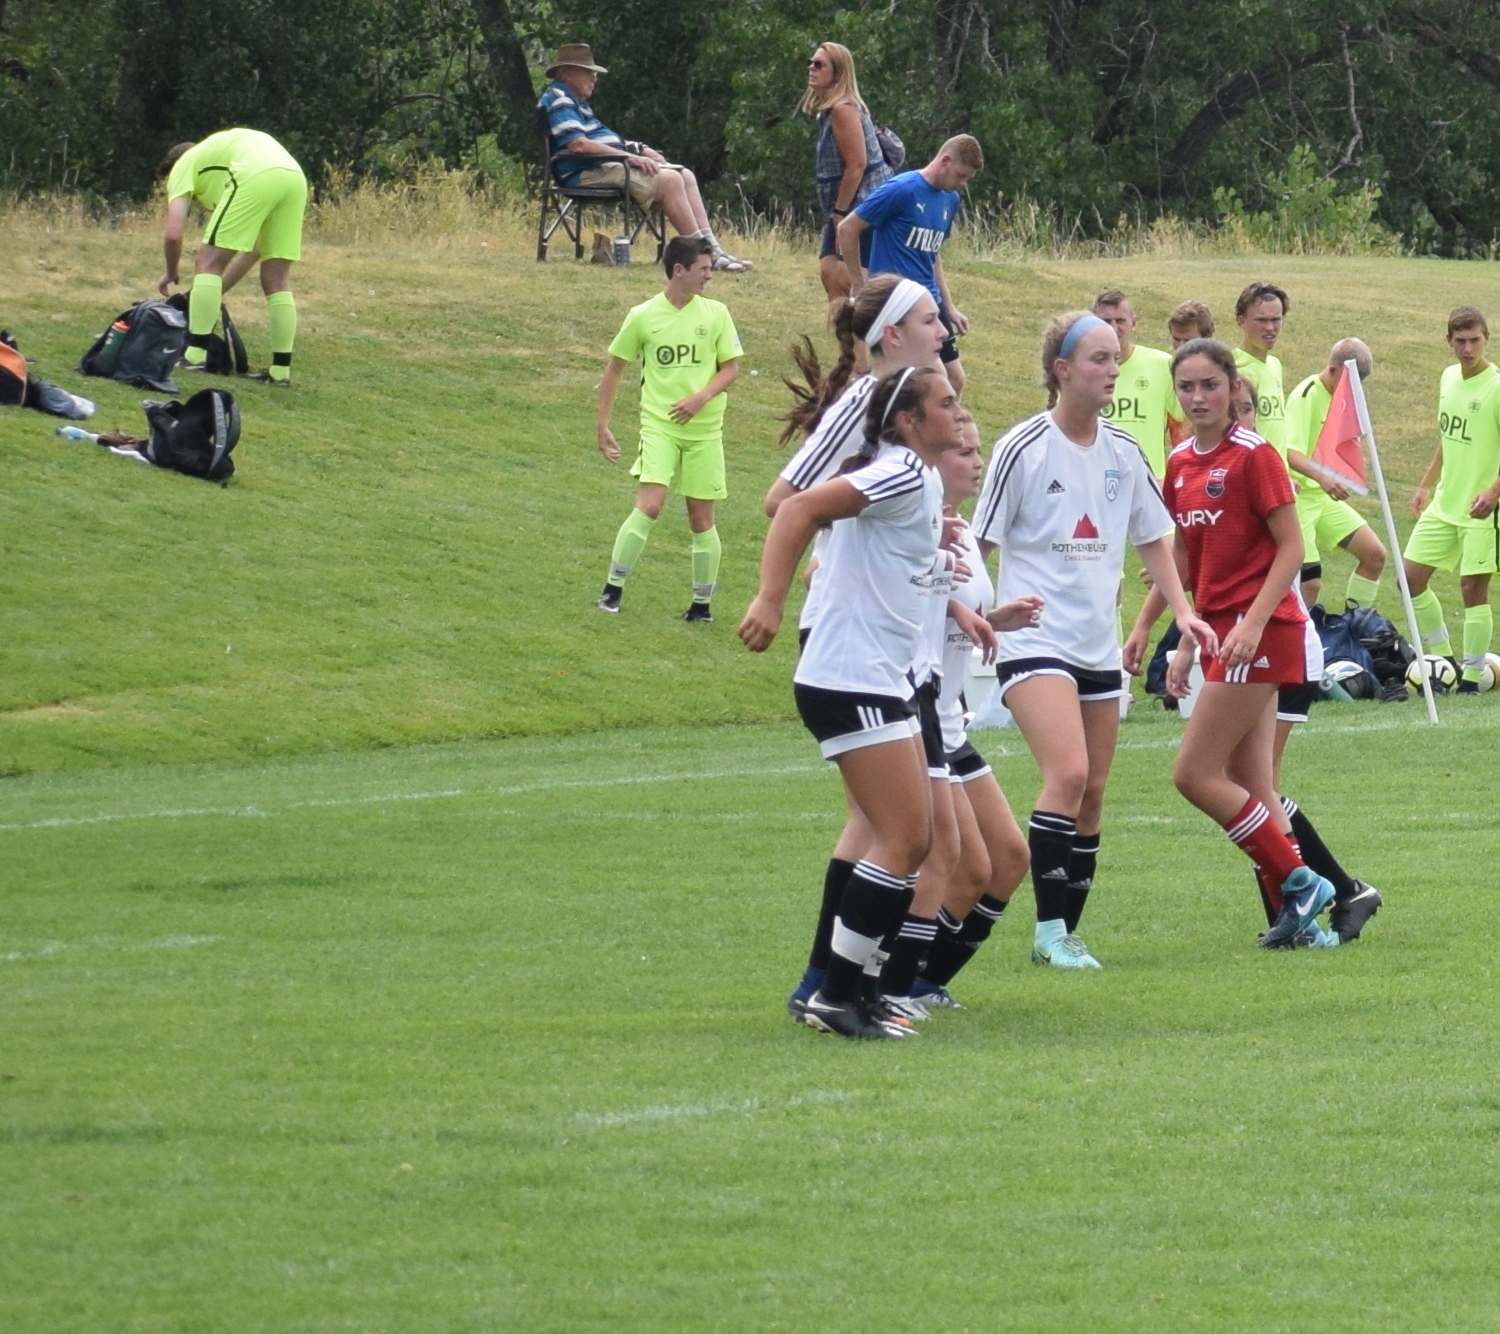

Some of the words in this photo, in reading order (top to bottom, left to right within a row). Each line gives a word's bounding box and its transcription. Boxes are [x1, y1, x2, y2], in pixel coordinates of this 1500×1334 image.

[905, 226, 945, 253] ITALIA
[656, 344, 702, 366] OPL
[1440, 411, 1473, 442] OPL
